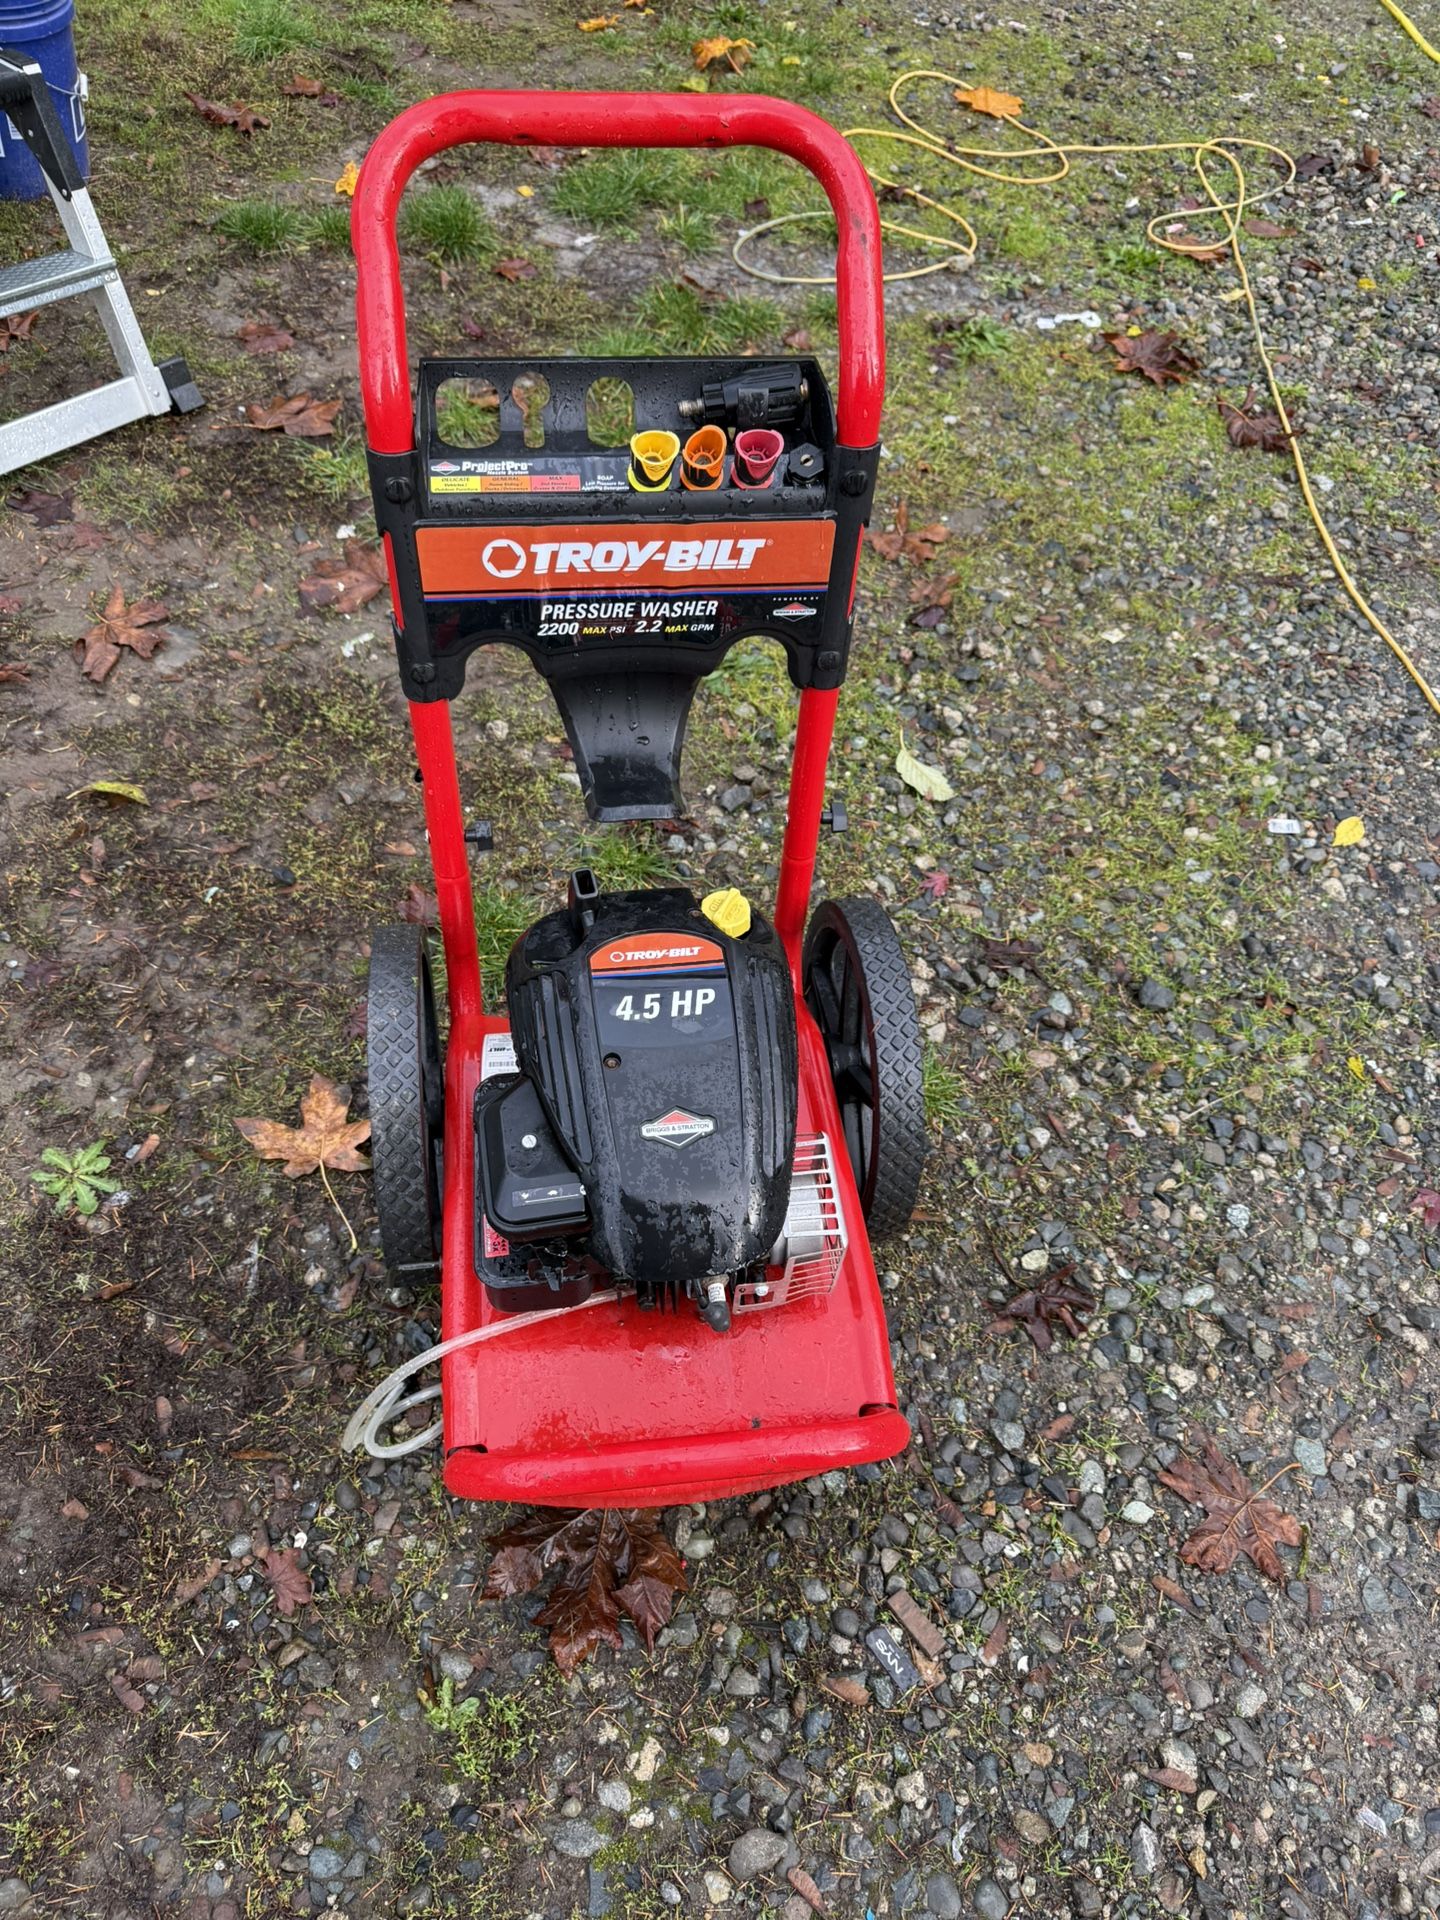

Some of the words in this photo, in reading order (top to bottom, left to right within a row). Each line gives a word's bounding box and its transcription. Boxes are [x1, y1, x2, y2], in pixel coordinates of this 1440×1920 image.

[461, 460, 528, 473] ProjectPro
[529, 538, 767, 574] TROY-BILT
[540, 602, 636, 621] PRESSURE
[640, 600, 719, 618] WASHER
[537, 622, 580, 636] 2200
[582, 626, 608, 635] MAX
[608, 626, 626, 634] PSI
[634, 620, 663, 633] 2.2
[664, 624, 689, 633] MAX
[690, 623, 714, 632] GPM
[623, 946, 701, 960] TROY-BILT
[615, 993, 661, 1021] 4.5
[670, 988, 716, 1018] HP
[645, 1126, 671, 1134] BRIGGS
[677, 1123, 710, 1131] STRATTON
[875, 1638, 904, 1674] NYS
